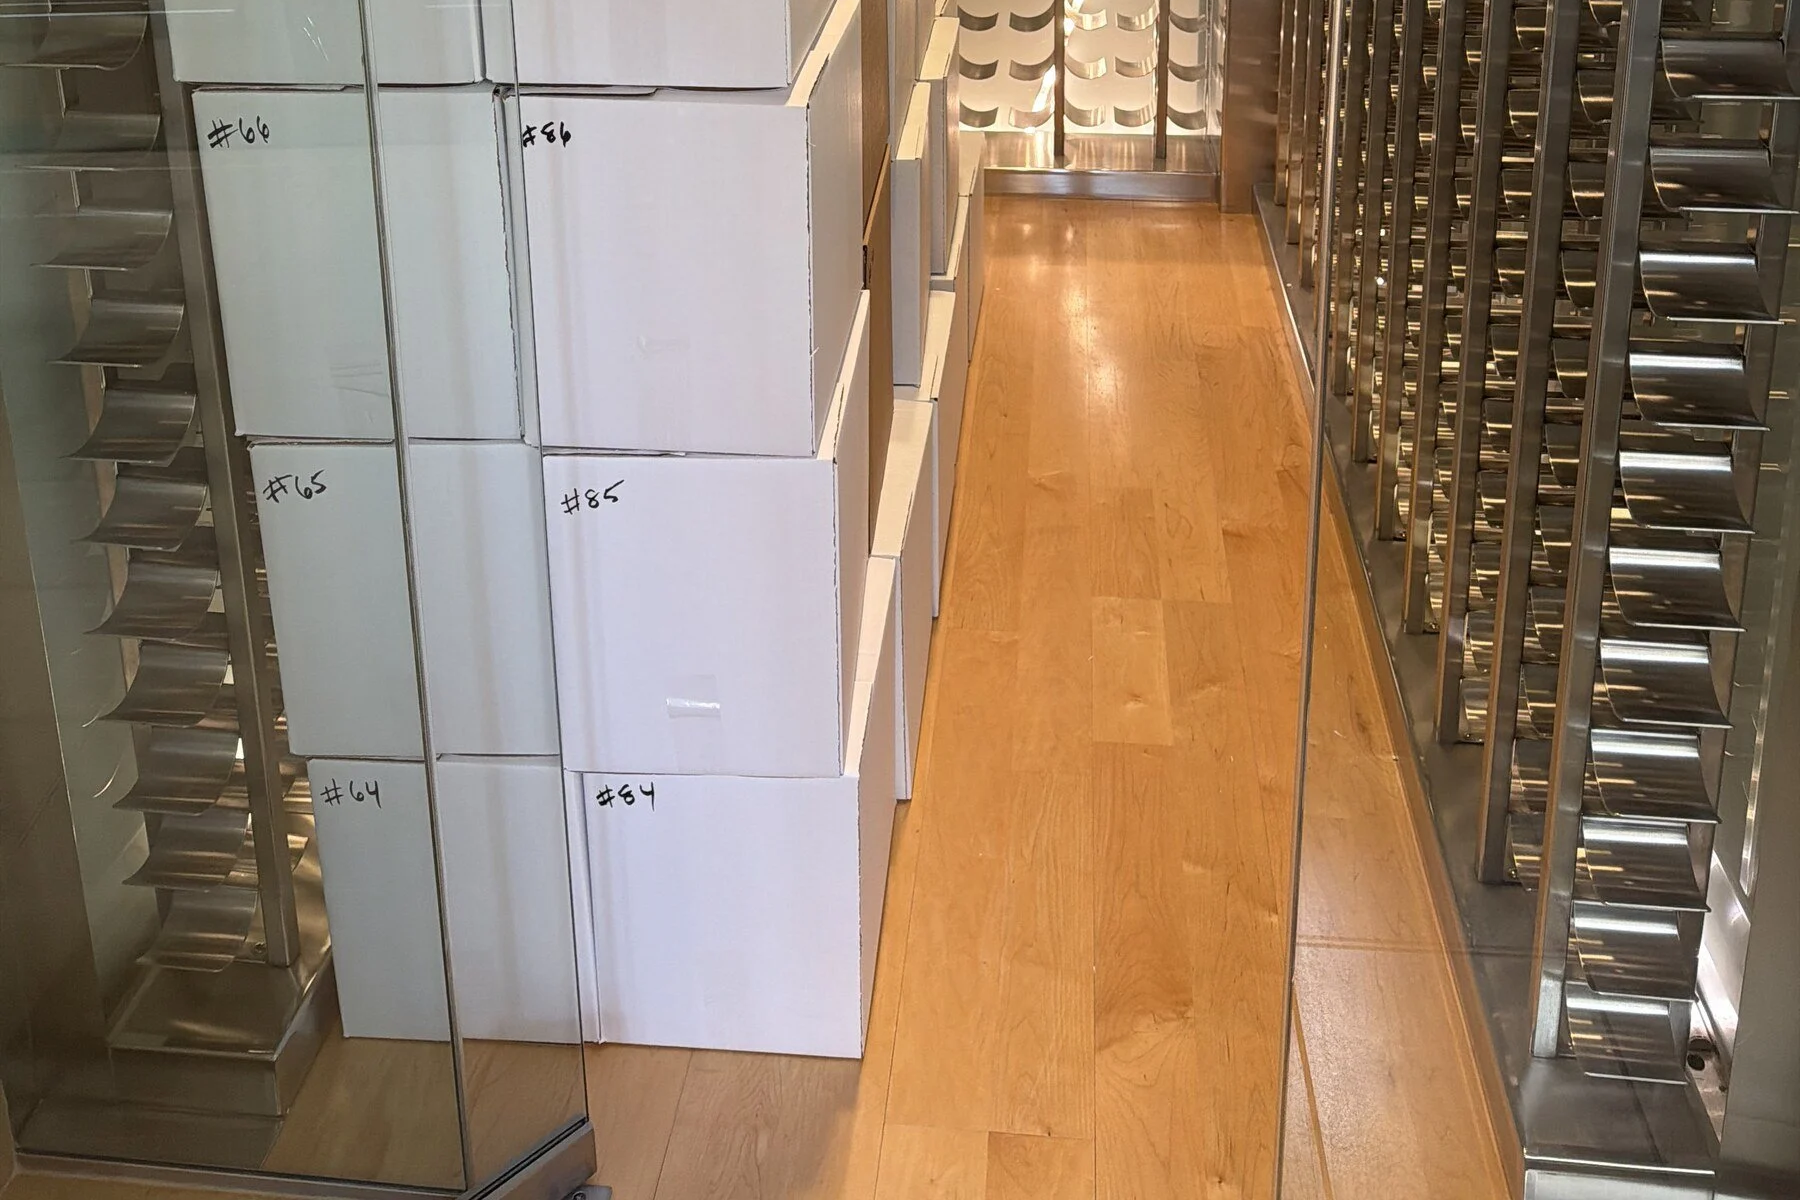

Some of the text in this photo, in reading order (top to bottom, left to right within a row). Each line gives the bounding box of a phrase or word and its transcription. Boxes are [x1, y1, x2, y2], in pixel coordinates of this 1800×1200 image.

[207, 115, 270, 149] #66
[522, 121, 572, 148] #86
[262, 469, 327, 504] #65
[560, 479, 625, 515] #85
[320, 778, 382, 809] #64
[595, 781, 655, 812] #84
